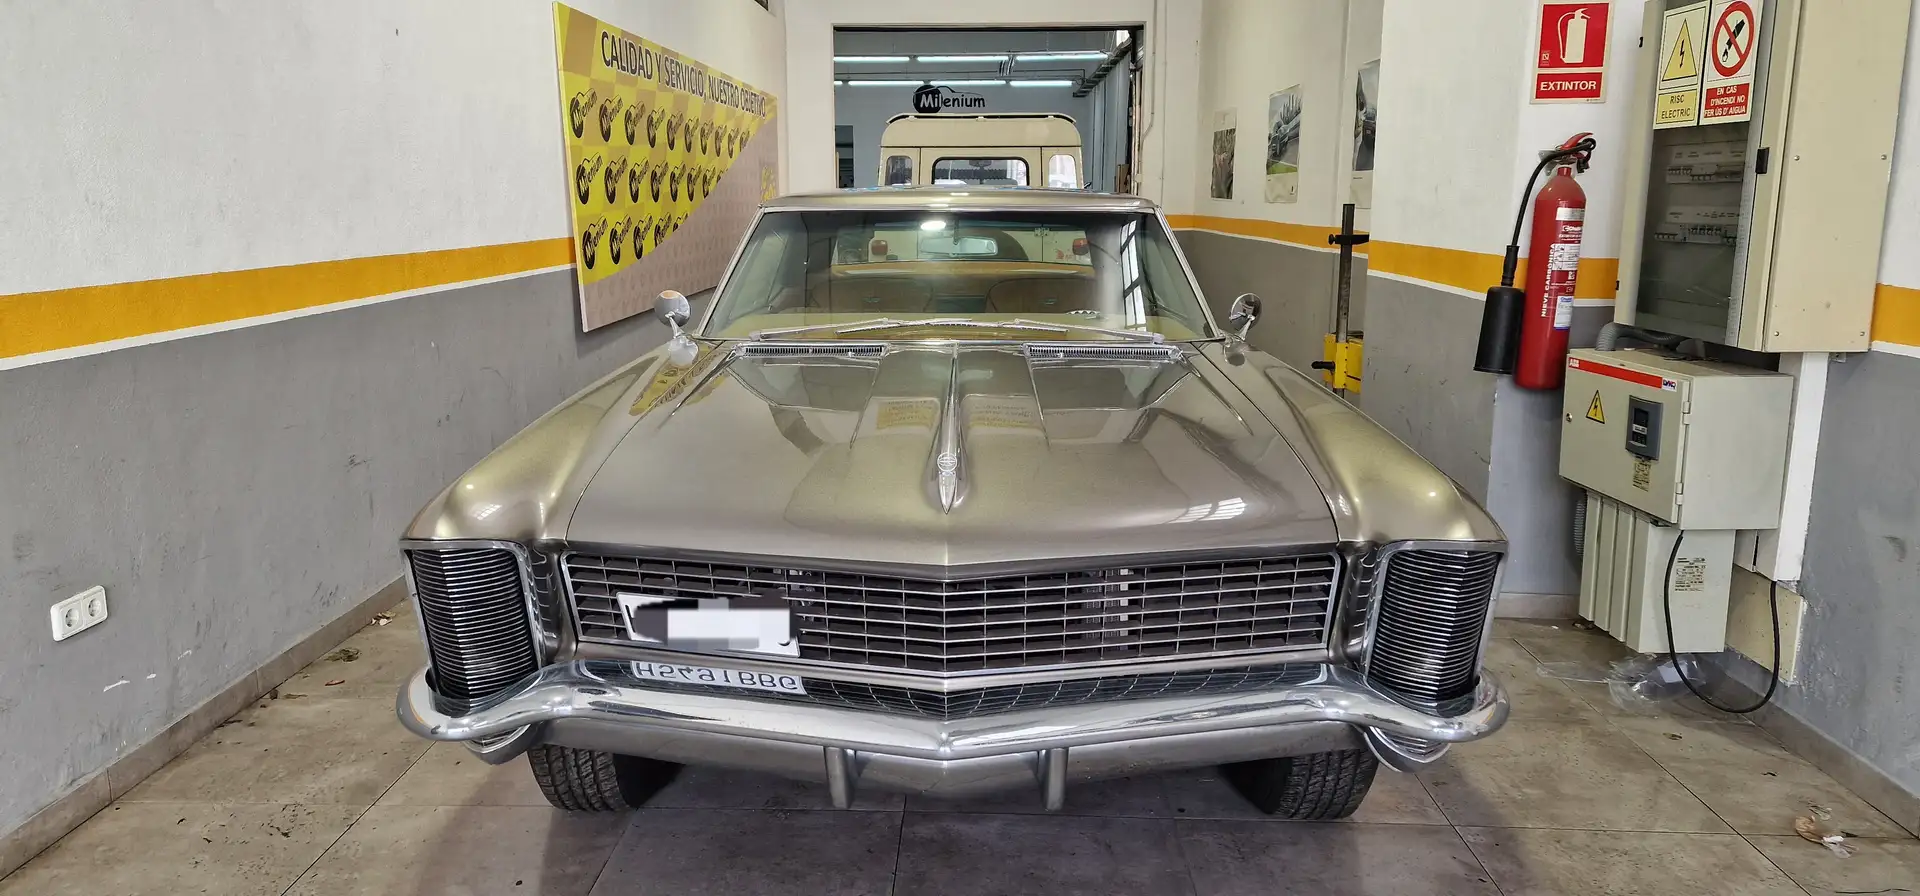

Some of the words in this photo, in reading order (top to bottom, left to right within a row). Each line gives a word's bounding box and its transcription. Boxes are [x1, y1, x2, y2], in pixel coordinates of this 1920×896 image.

[601, 31, 653, 80] CALIDAD
[654, 52, 662, 83] Y
[664, 56, 707, 102] SERVICIO,
[708, 75, 739, 109] NUESTRO
[740, 87, 766, 117] OBJETIVO
[1540, 80, 1597, 91] EXTINTOR
[1717, 87, 1724, 96] EN
[1726, 85, 1737, 94] CAS
[920, 94, 986, 108] Milenium
[1670, 94, 1685, 104] RISC
[1710, 96, 1736, 106] D'INCENDI
[1736, 94, 1745, 103] NO
[1661, 107, 1691, 119] ELECTRIC
[1704, 109, 1714, 117] FER
[1728, 105, 1746, 115] AIGUA
[1541, 292, 1549, 317] NIEVE
[1545, 243, 1555, 291] CARBÓNICA
